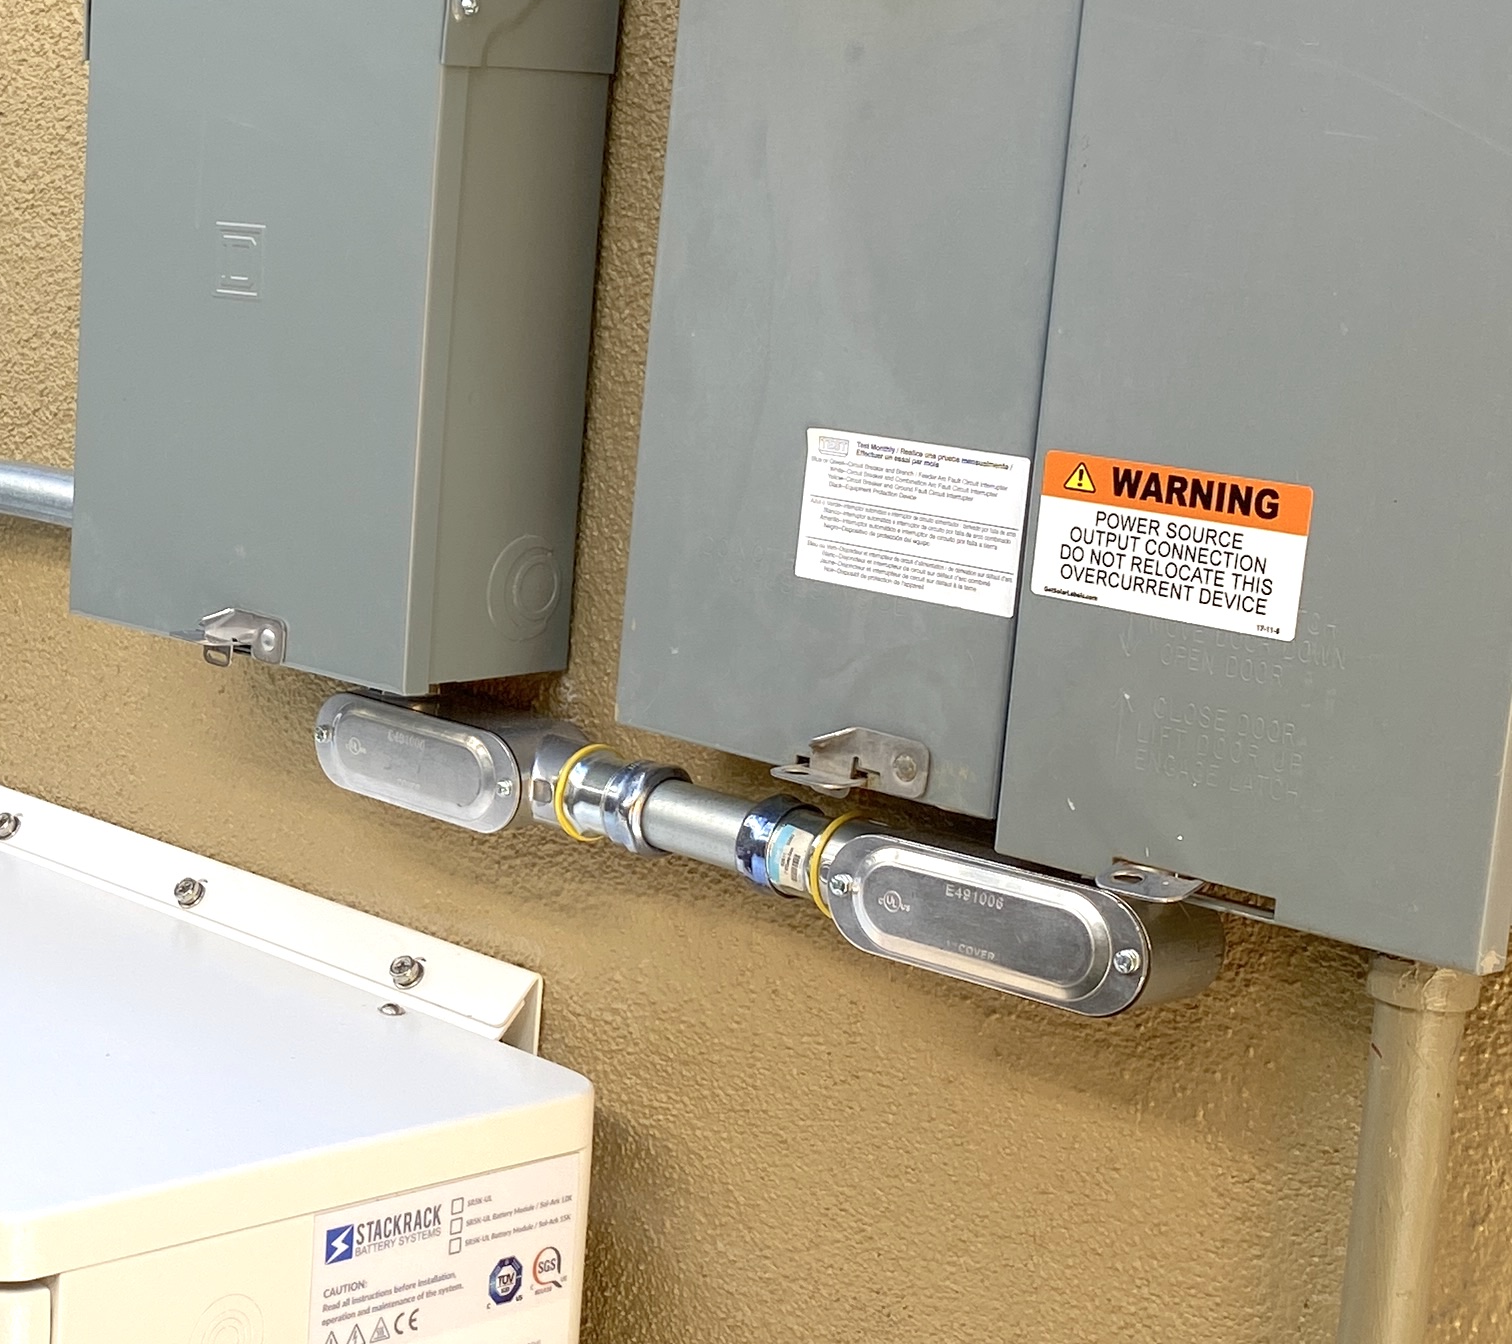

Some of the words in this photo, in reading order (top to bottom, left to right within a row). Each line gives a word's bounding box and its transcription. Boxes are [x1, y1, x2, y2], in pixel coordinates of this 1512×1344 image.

[871, 444, 895, 454] Monthly
[1112, 466, 1279, 520] WARNING
[1095, 511, 1160, 536] POWER
[1166, 523, 1243, 550] SOURCE
[1070, 527, 1139, 552] OUTPUT
[1144, 539, 1266, 574] CONNECTION
[1060, 544, 1084, 562] DO
[1090, 549, 1125, 569] NOT
[1131, 556, 1224, 587] RELOCATE
[1231, 574, 1272, 596] THIS
[1044, 586, 1098, 601] GetSolarLabels.com
[1060, 564, 1196, 601] OVERCURRENT
[1199, 589, 1267, 615] DEVICE
[1153, 697, 1228, 732] CLOSE
[1238, 714, 1295, 745] DOOR
[945, 884, 1004, 910] E491006
[958, 943, 996, 961] COVER
[356, 1204, 442, 1245] STACKRACK
[492, 1208, 513, 1220] Battery
[514, 1204, 535, 1214] Module
[355, 1239, 395, 1257] BATTERY
[398, 1227, 441, 1246] SYSTEMS
[491, 1228, 512, 1240] Battery
[513, 1224, 533, 1234] Module
[538, 1258, 556, 1274] SGS
[322, 1302, 340, 1313] Read
[342, 1299, 350, 1308] all
[352, 1289, 392, 1305] instructions
[394, 1282, 416, 1293] before
[322, 1309, 356, 1326] operation
[358, 1307, 370, 1317] and
[372, 1295, 415, 1313] maintenance
[417, 1291, 425, 1300] of
[426, 1289, 437, 1298] the
[438, 1283, 464, 1296] system.
[323, 1280, 368, 1299] CAUTION:
